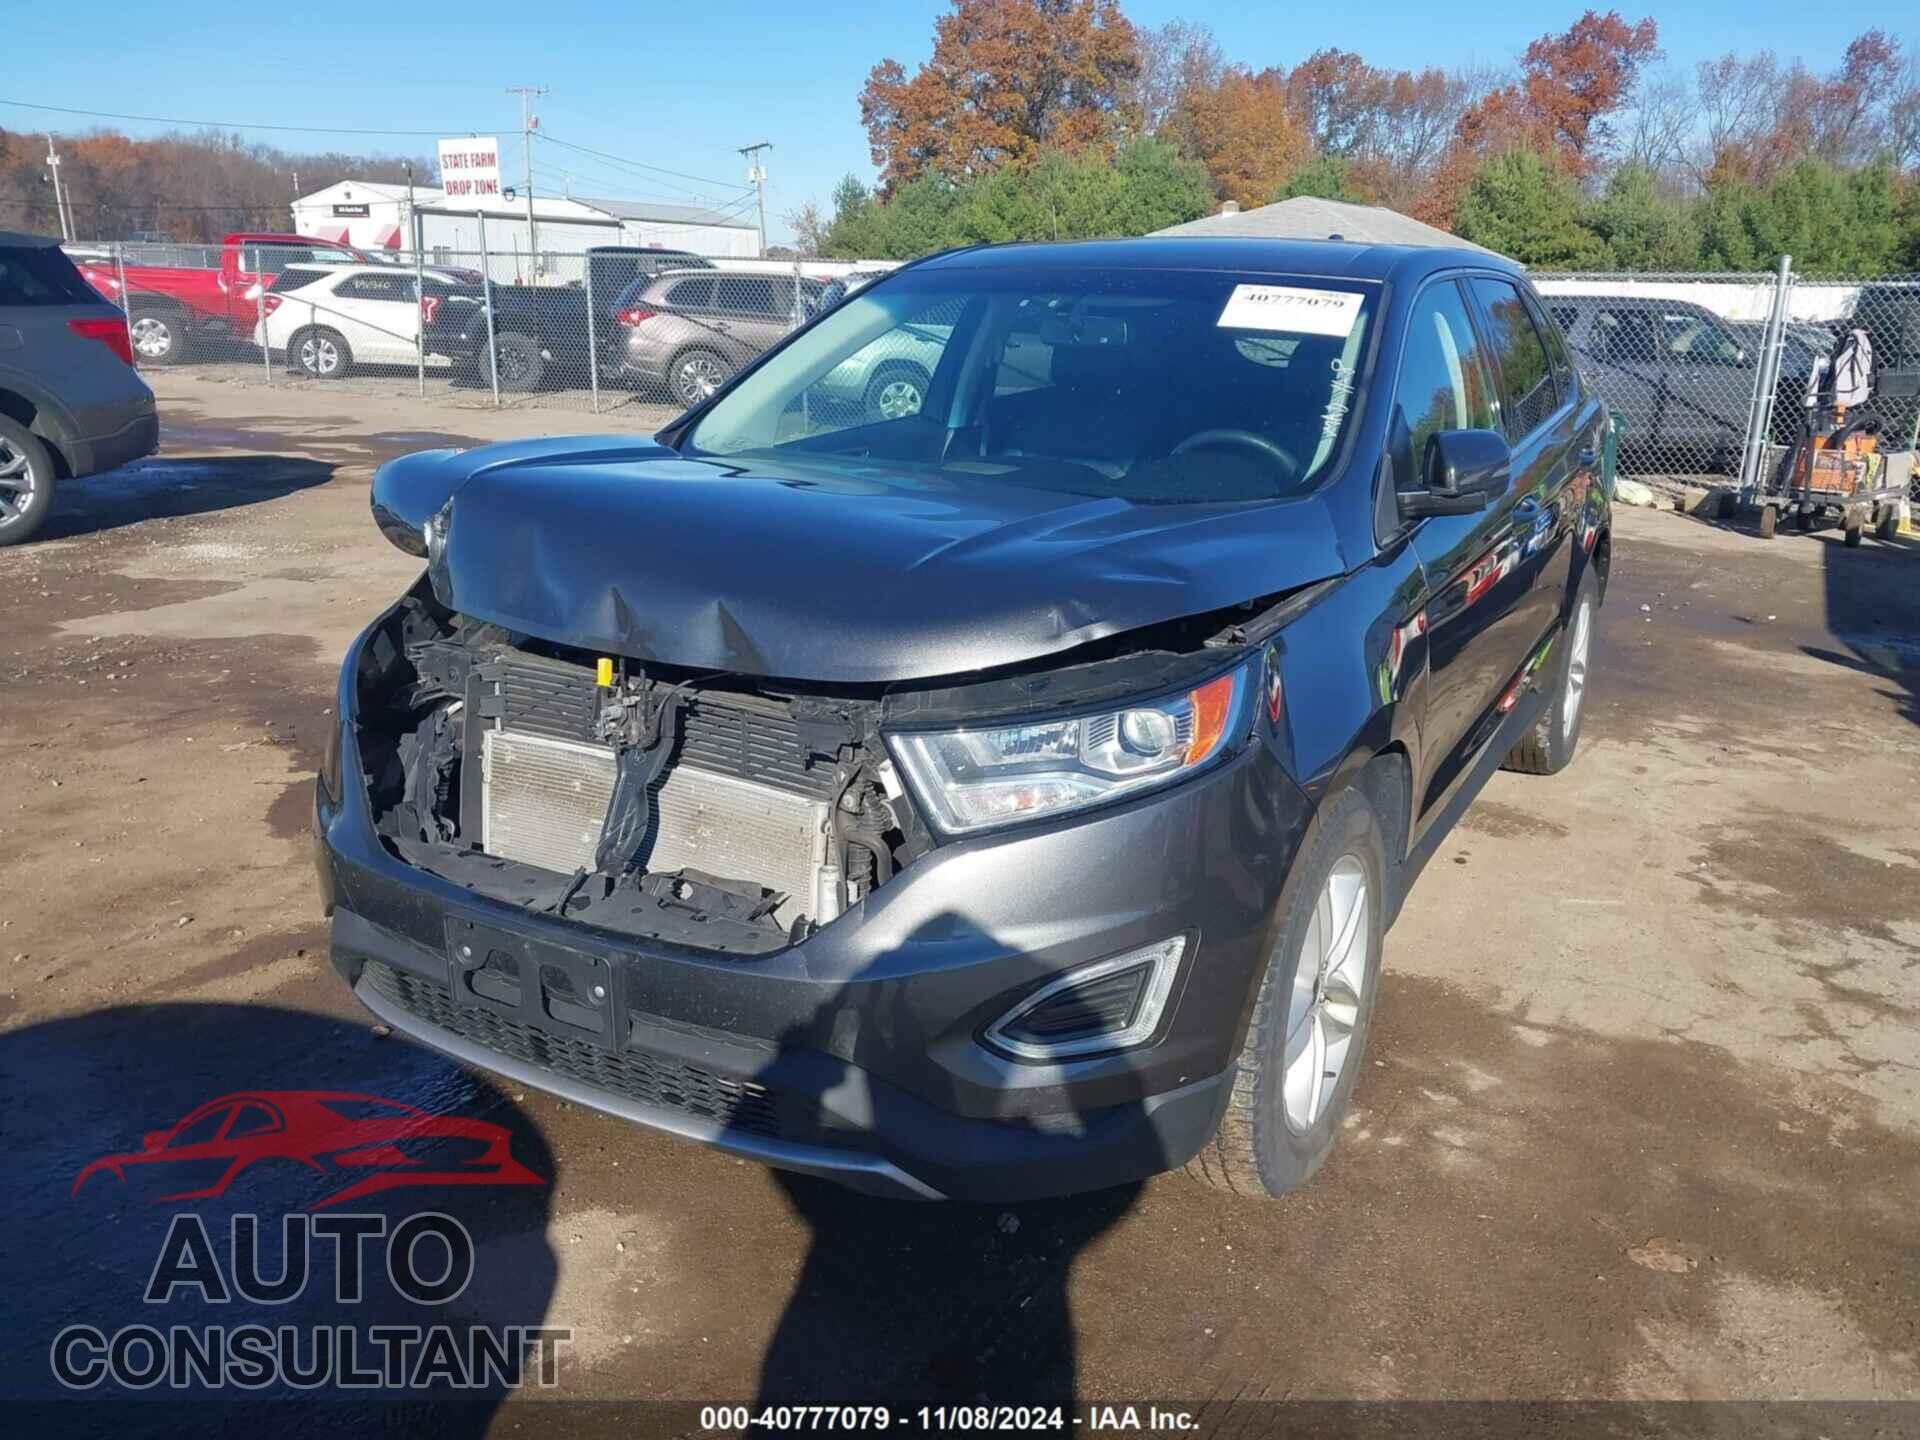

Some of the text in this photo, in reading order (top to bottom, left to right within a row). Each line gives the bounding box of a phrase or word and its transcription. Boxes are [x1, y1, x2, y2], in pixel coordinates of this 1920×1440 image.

[441, 152, 496, 169] STATE FARM
[445, 178, 499, 195] DROP ZONE
[1243, 293, 1345, 309] 40777079
